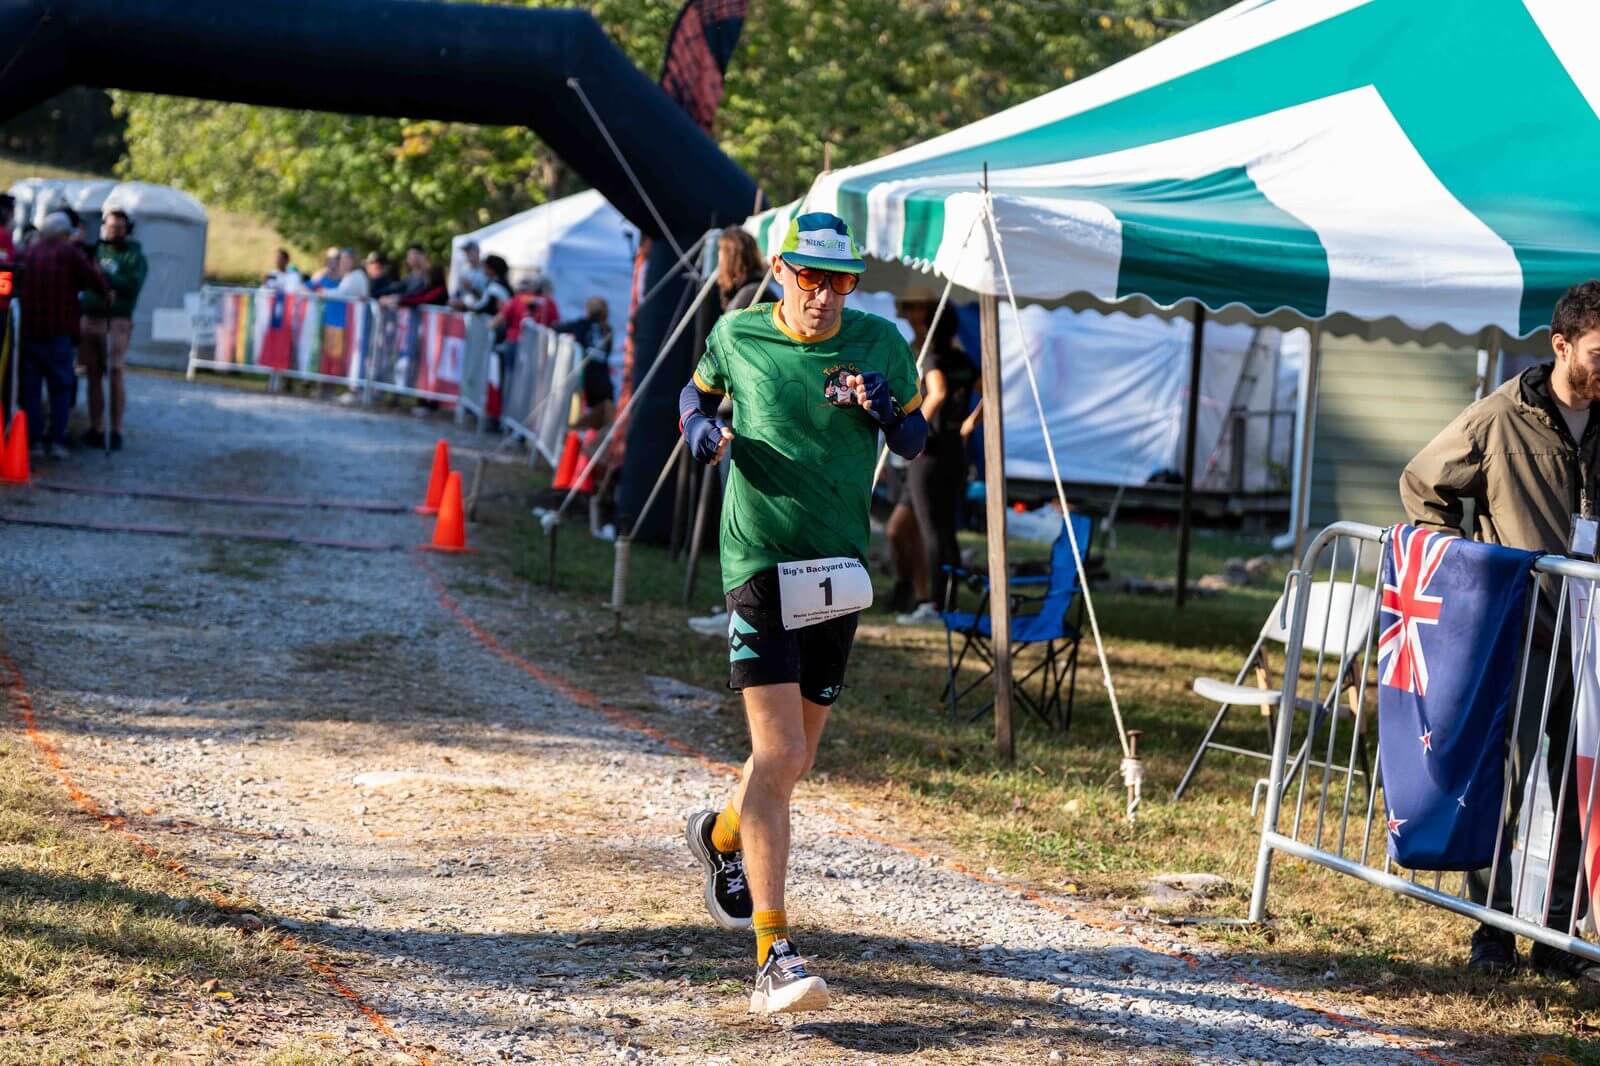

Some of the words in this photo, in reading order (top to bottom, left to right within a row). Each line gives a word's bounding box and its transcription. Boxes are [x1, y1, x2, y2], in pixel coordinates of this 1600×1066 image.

[782, 567, 804, 577] Big's
[806, 563, 844, 573] Backyard
[819, 577, 833, 607] 1
